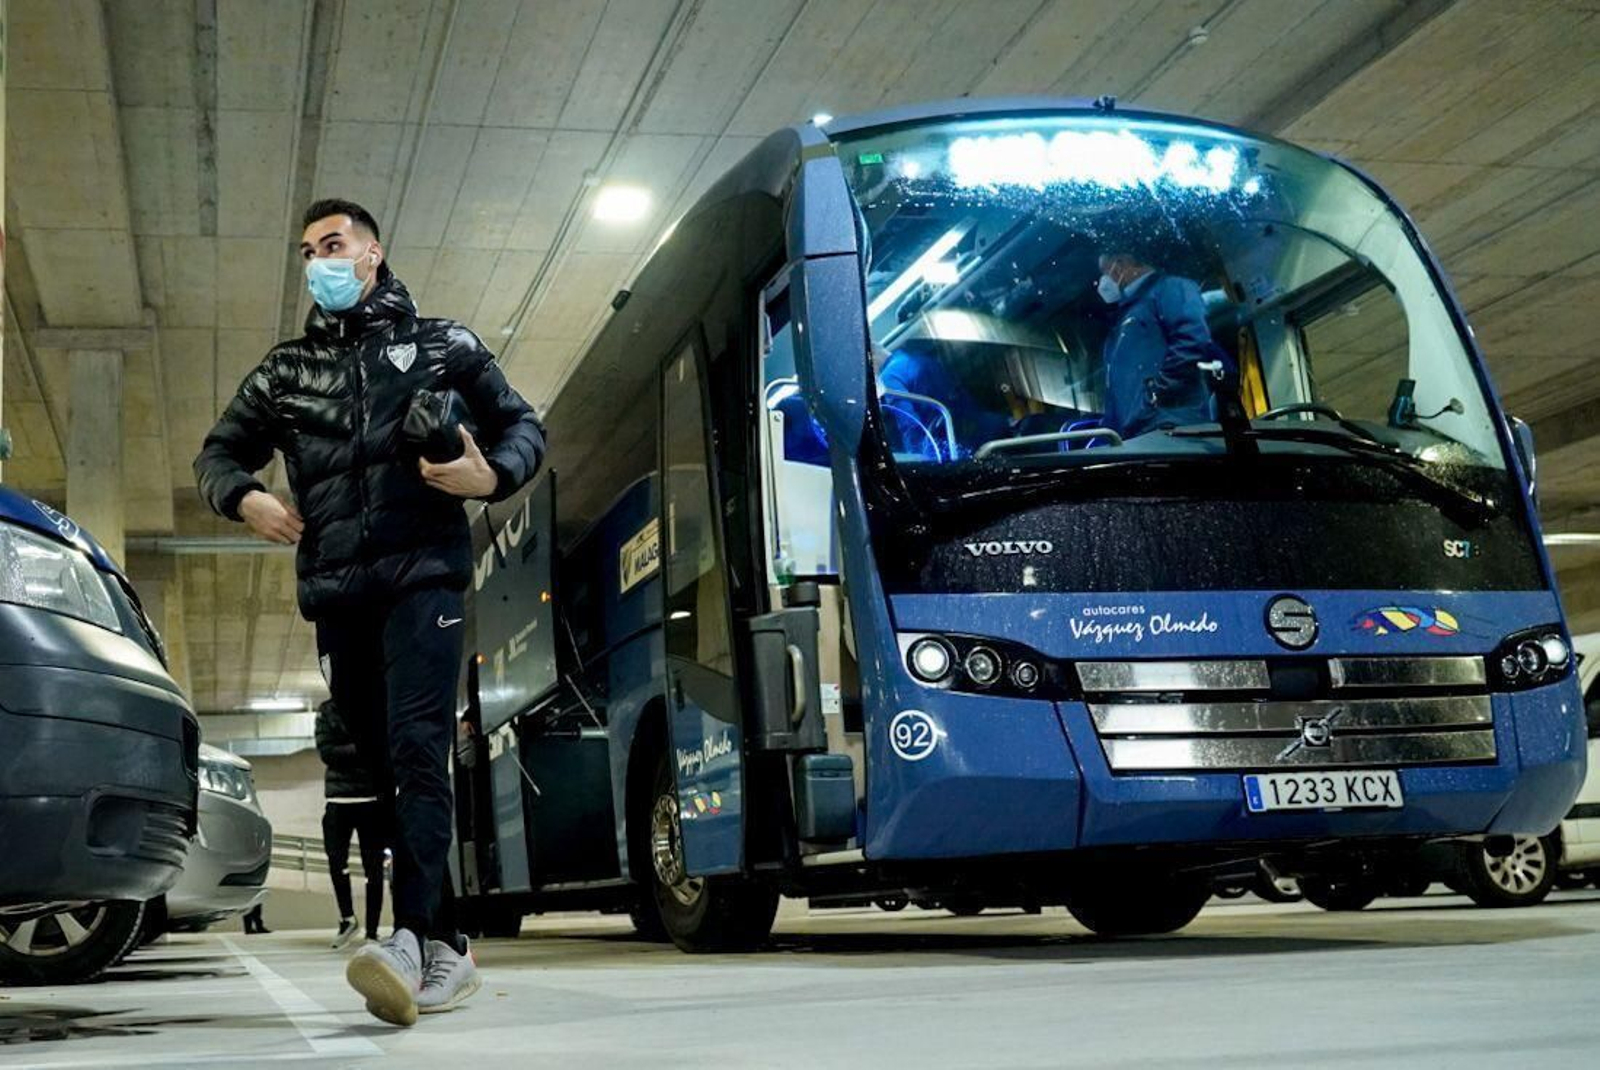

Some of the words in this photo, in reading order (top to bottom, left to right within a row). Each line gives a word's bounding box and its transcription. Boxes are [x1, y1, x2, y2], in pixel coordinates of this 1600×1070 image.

[964, 540, 1053, 557] VOLVO
[1443, 539, 1471, 558] SC7
[1082, 604, 1146, 617] autocares
[1069, 617, 1145, 643] Vázquez
[1149, 611, 1218, 636] Olmedo
[896, 722, 930, 748] 92
[1269, 777, 1337, 805] 1233
[1344, 775, 1396, 802] KCX
